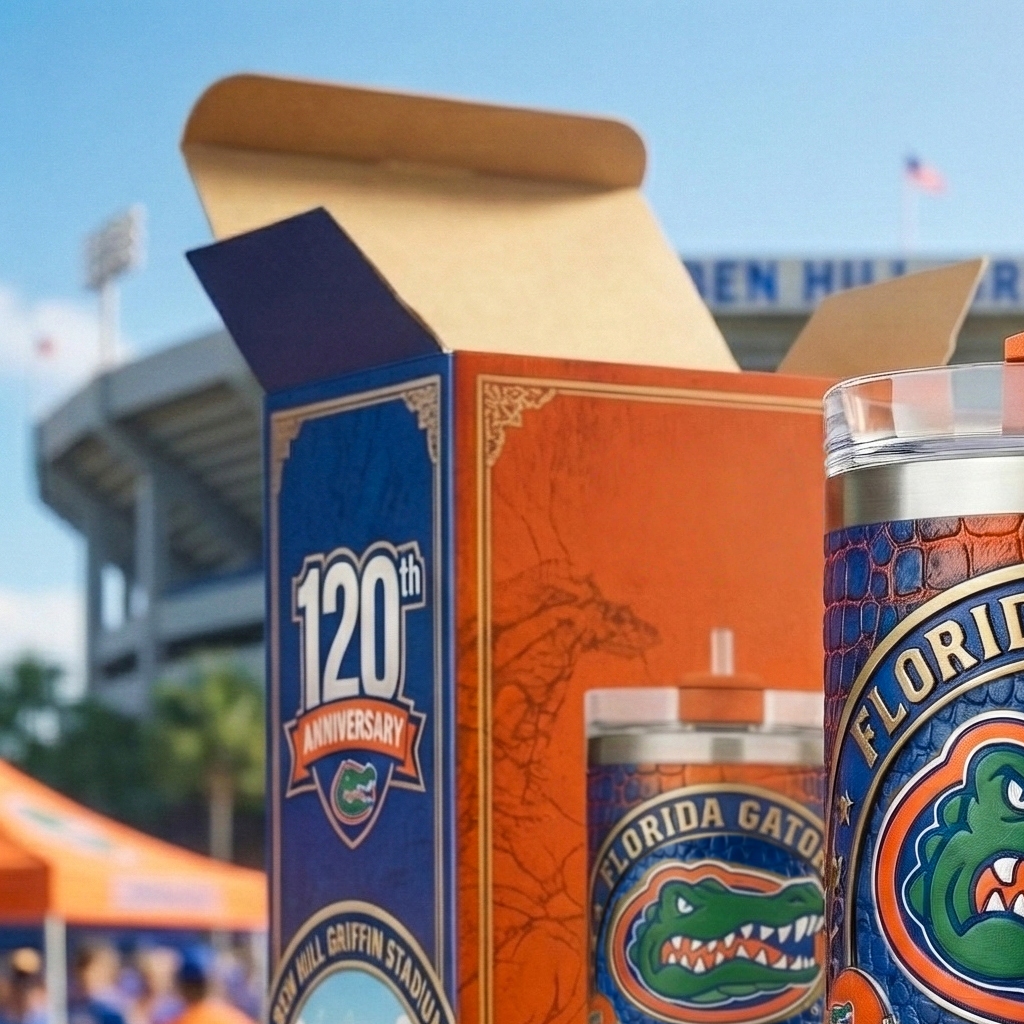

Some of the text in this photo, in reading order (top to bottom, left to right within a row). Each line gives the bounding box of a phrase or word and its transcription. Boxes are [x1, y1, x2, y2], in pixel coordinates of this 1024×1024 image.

[297, 553, 421, 711] 120th
[302, 708, 405, 755] ANNIVERSARY
[600, 797, 725, 890] FLORIDA
[326, 920, 384, 961] GRIFFIN
